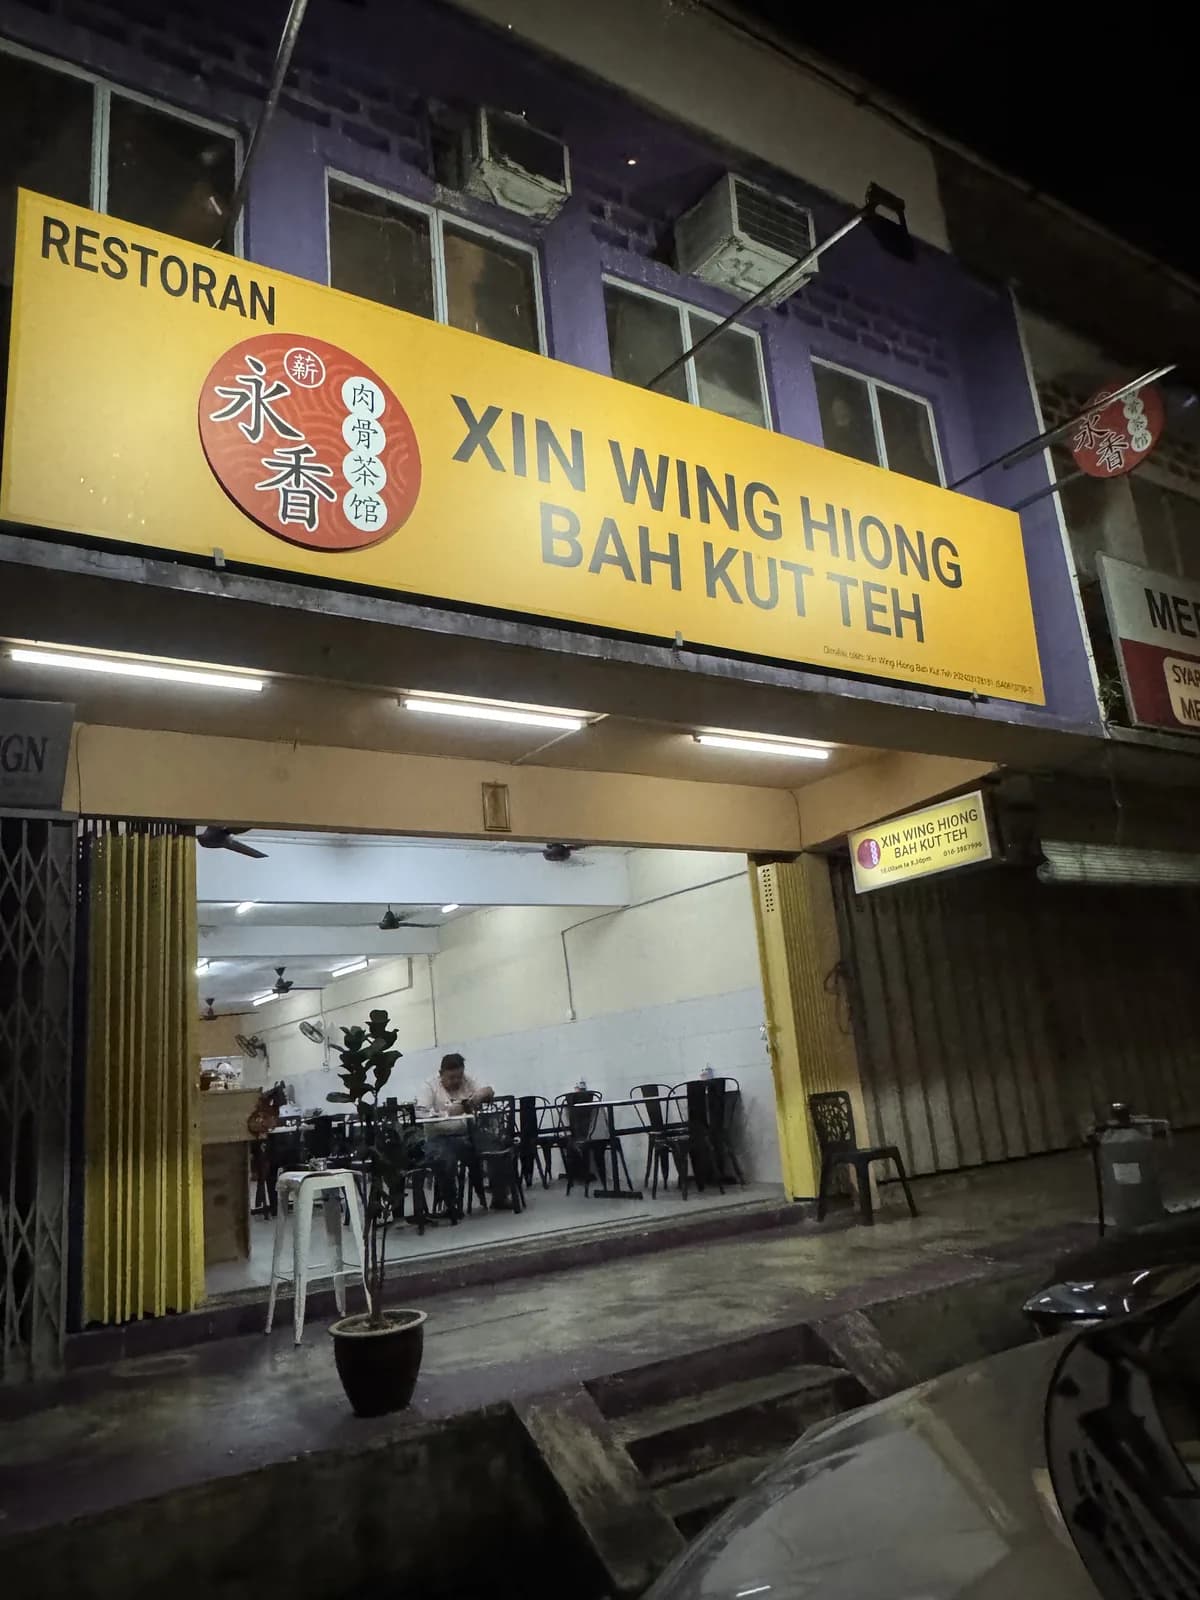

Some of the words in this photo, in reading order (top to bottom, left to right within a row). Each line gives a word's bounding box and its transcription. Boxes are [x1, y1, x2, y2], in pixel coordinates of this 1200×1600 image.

[41, 216, 276, 325] RESTORAN
[348, 383, 380, 524] 肉骨茶馆
[451, 394, 586, 493] XIN
[608, 439, 783, 541] WING
[800, 496, 964, 589] HIONG
[539, 502, 682, 592] BAH
[703, 540, 814, 617] KUT
[826, 571, 926, 643] TEH
[881, 832, 901, 849] XIN
[902, 821, 935, 840] WING
[937, 808, 978, 828] HIONG
[894, 844, 917, 859] BAH
[920, 835, 942, 850] KUT
[943, 827, 968, 844] TEH
